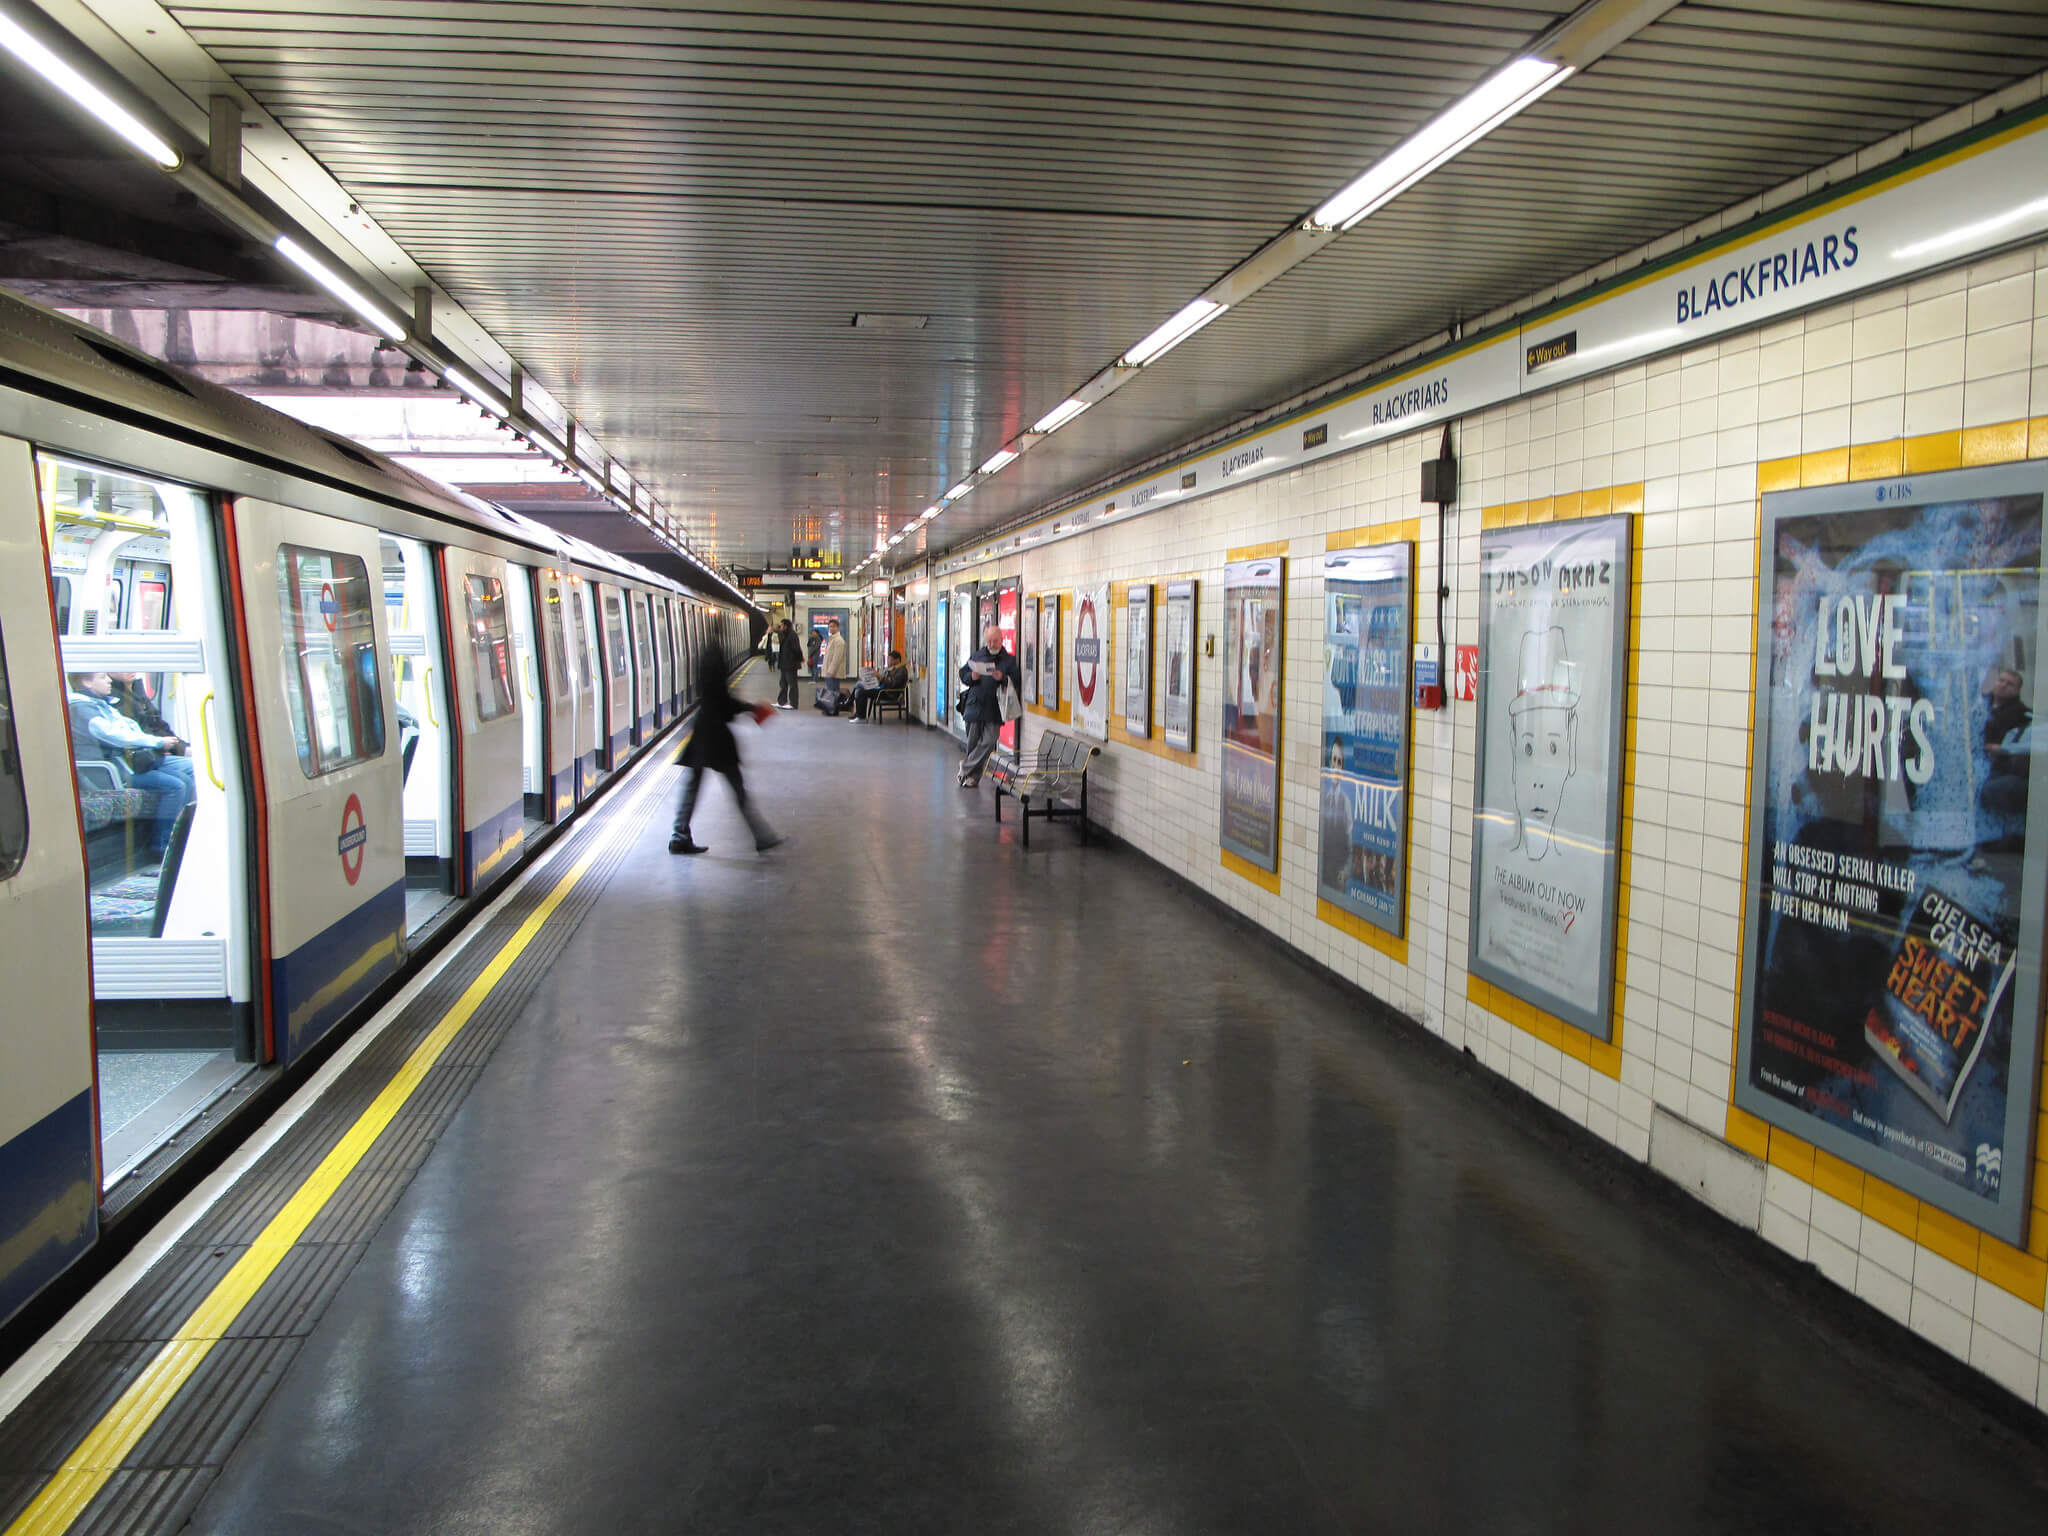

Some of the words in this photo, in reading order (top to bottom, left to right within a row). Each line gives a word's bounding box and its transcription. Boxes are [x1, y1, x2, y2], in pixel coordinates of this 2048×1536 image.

[1677, 226, 1859, 324] BLACKFRIARS
[1535, 345, 1553, 363] Way
[1553, 341, 1567, 355] out
[1373, 377, 1449, 425] BLACKFRIARS
[1222, 446, 1264, 478] BLACKFRIARS
[1888, 483, 1912, 499] CBS
[1814, 593, 1907, 680] LOVE
[1808, 692, 1935, 785] HURTS
[1353, 783, 1398, 832] MILK
[1494, 865, 1507, 886] THE
[1508, 873, 1536, 897] ALBUM
[1537, 882, 1557, 904] OUT
[1558, 891, 1586, 913] NOW
[1772, 865, 1792, 890] WILL
[1794, 871, 1817, 897] STOP
[1818, 878, 1833, 900] AT
[1834, 882, 1879, 913] NOTHING
[1773, 841, 1788, 862] AN
[1788, 845, 1835, 874] OBSESSED
[1838, 856, 1875, 884] SERIAL
[1876, 864, 1916, 893] KILLER
[1771, 891, 1782, 912] TO
[1782, 894, 1800, 918] GET
[1801, 901, 1820, 924] HER
[1822, 907, 1850, 933] MAN.
[1922, 893, 2001, 965] CHELSEA
[1930, 923, 1980, 972] CAIN
[1899, 935, 1988, 1014] SWEET
[1887, 961, 1978, 1049] HEART
